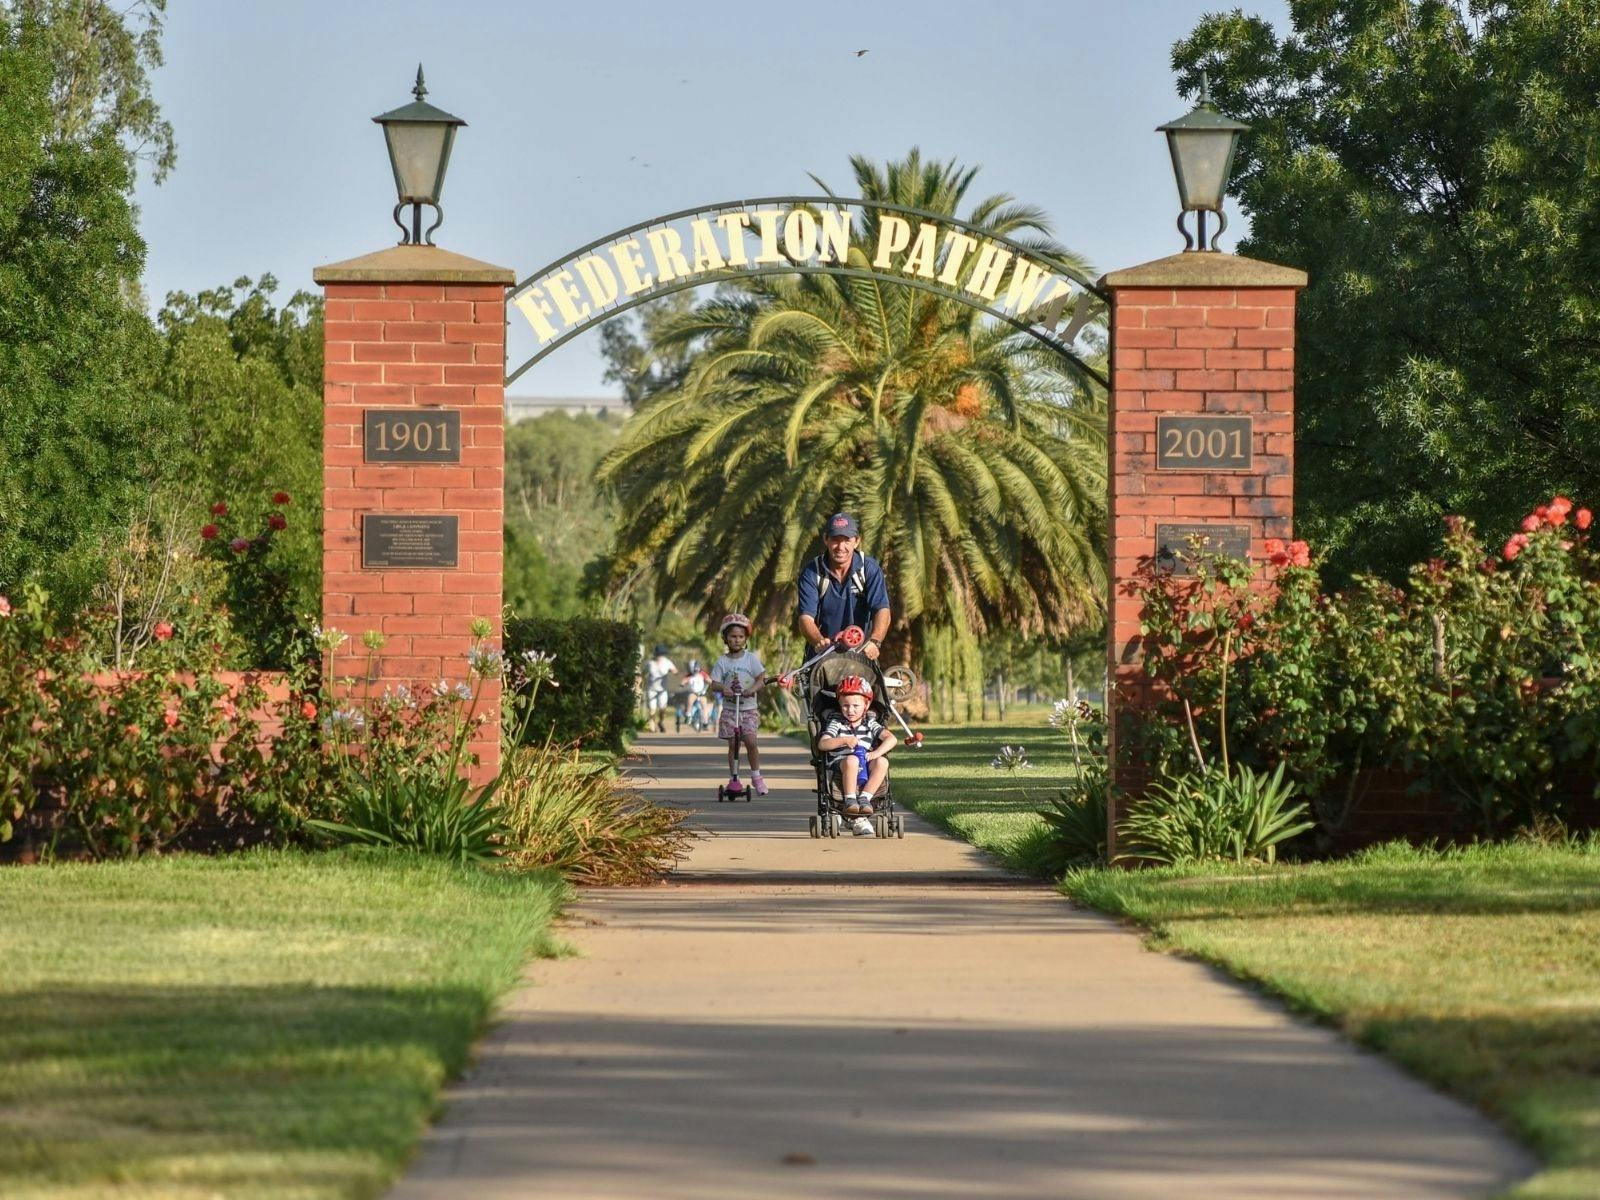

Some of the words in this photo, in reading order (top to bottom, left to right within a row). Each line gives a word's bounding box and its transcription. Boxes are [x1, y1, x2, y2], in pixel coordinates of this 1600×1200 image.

[513, 209, 852, 345] FEDERATION
[873, 214, 1105, 346] PATHWAY
[374, 421, 452, 452] 1901
[1164, 428, 1245, 459] 2001
